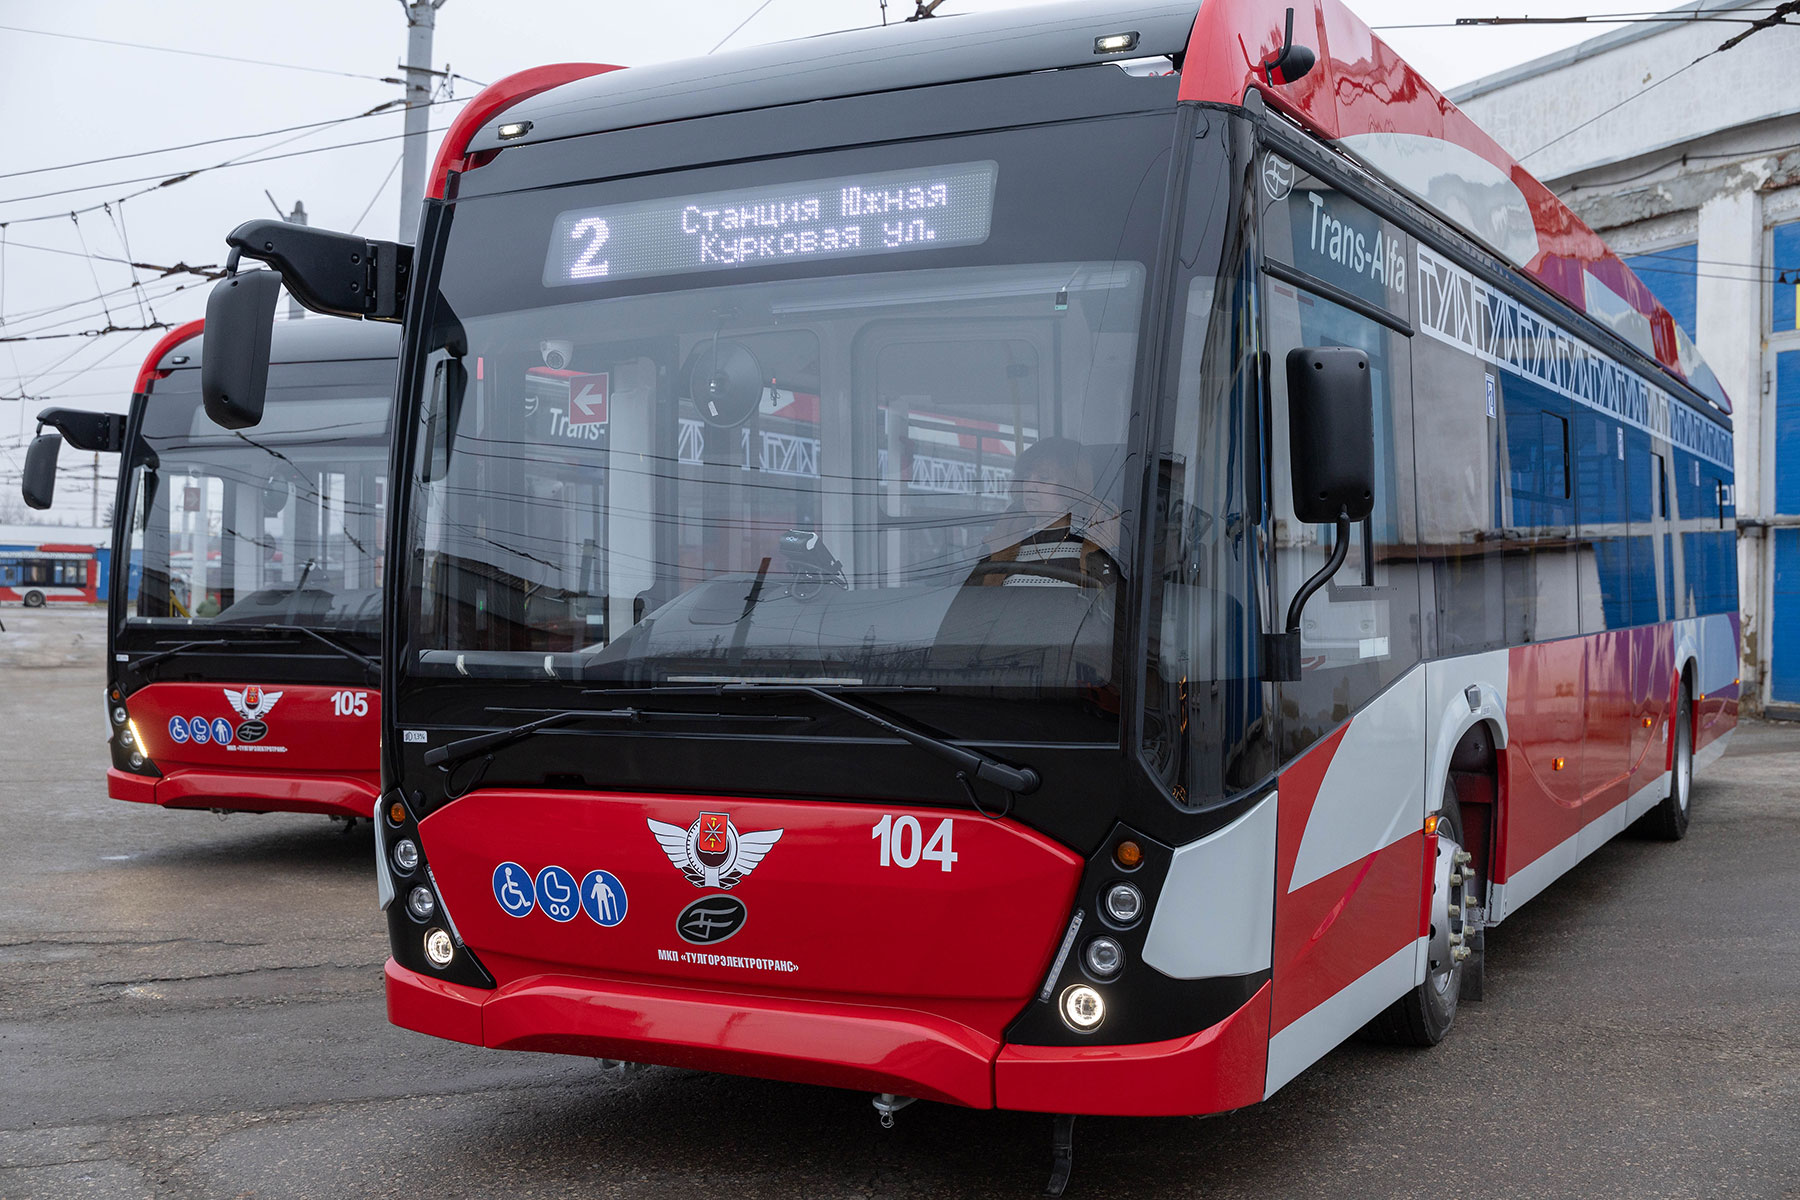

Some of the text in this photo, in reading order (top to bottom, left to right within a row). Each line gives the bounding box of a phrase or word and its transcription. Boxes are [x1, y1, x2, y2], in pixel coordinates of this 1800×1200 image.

[683, 184, 948, 234] Станция Южная
[570, 216, 610, 279] 2
[701, 219, 935, 264] Курковая ул.
[1308, 191, 1406, 294] Trans-Alfa
[331, 691, 369, 717] 105
[872, 814, 958, 872] 104
[658, 949, 799, 973] МКП «ТУЛГОРЭЛЕКТРОТРАНС»
